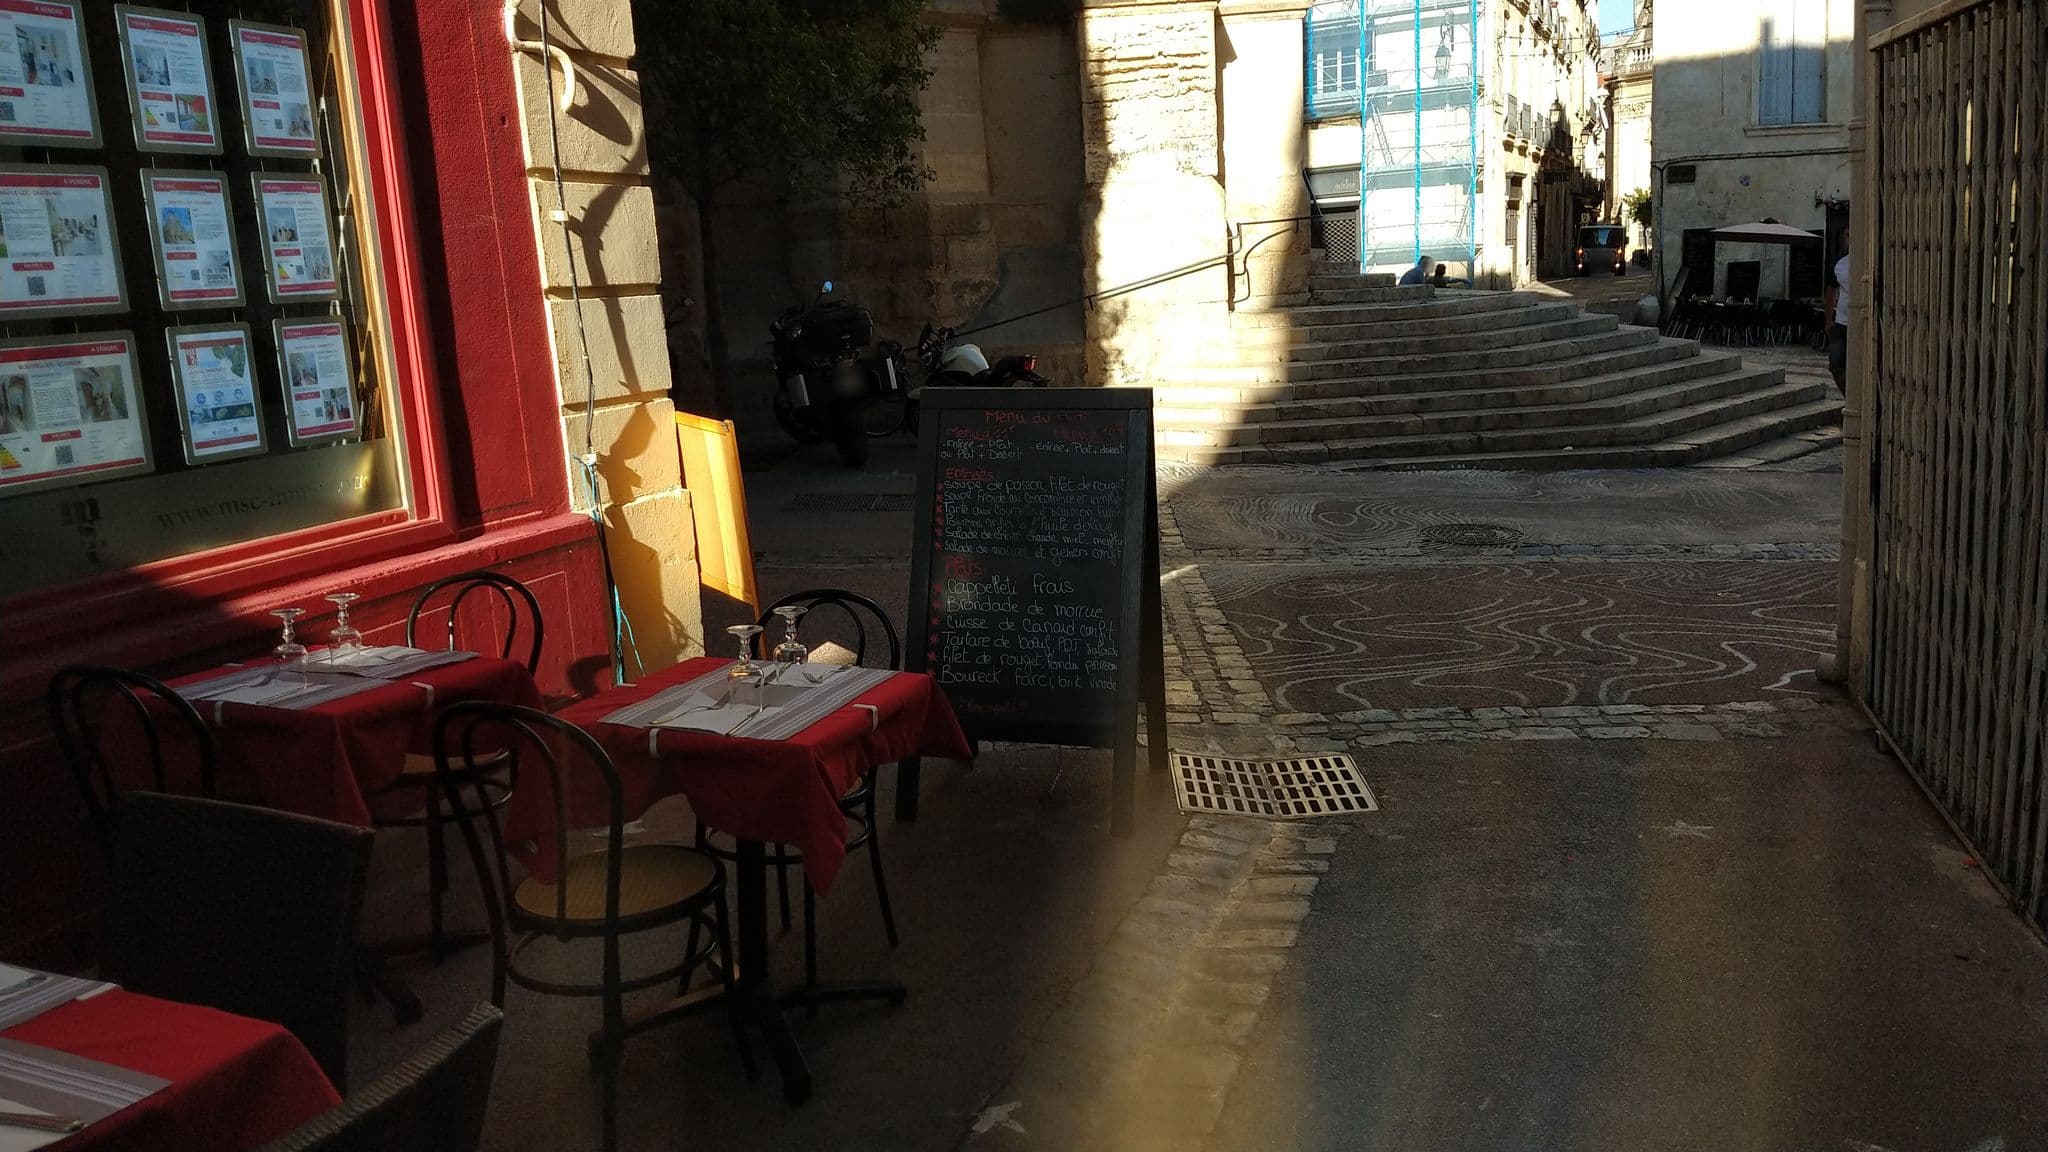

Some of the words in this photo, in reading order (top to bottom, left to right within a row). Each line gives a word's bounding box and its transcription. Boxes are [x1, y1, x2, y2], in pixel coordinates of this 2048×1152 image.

[986, 480, 1003, 490] de
[1077, 475, 1092, 490] de
[1027, 599, 1045, 615] de
[998, 616, 1016, 631] de
[941, 630, 991, 647] Tartare
[993, 632, 1011, 648] de
[975, 649, 992, 665] de
[937, 664, 1002, 685] Boureck
